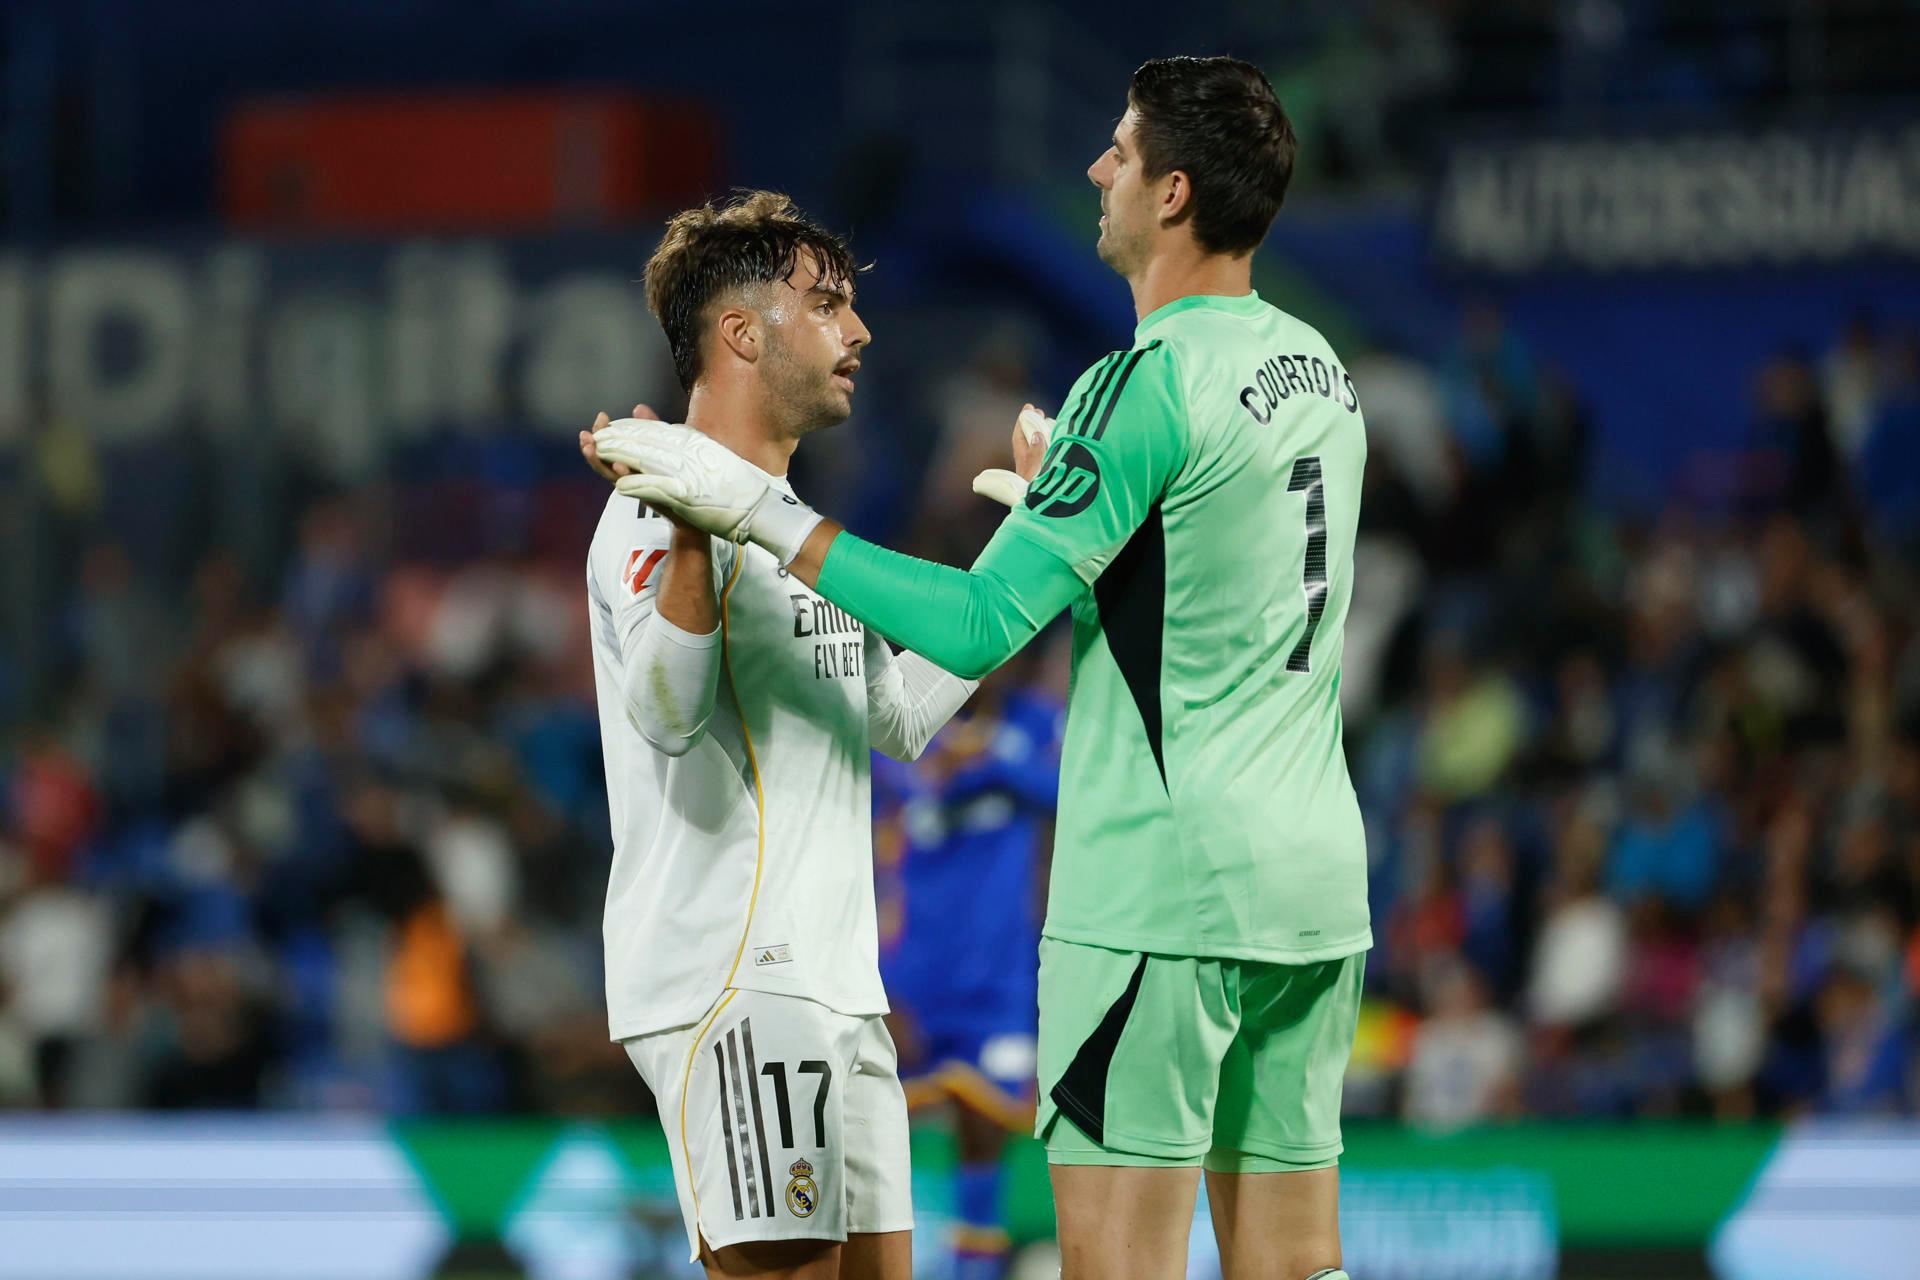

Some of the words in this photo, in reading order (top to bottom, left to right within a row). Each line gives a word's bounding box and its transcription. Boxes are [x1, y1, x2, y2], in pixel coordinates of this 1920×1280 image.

[1240, 355, 1357, 425] COURTOIS
[1028, 440, 1098, 515] hp
[1286, 456, 1328, 673] 1
[815, 643, 838, 679] FLY
[842, 642, 863, 677] BET
[761, 1060, 832, 1149] 17
